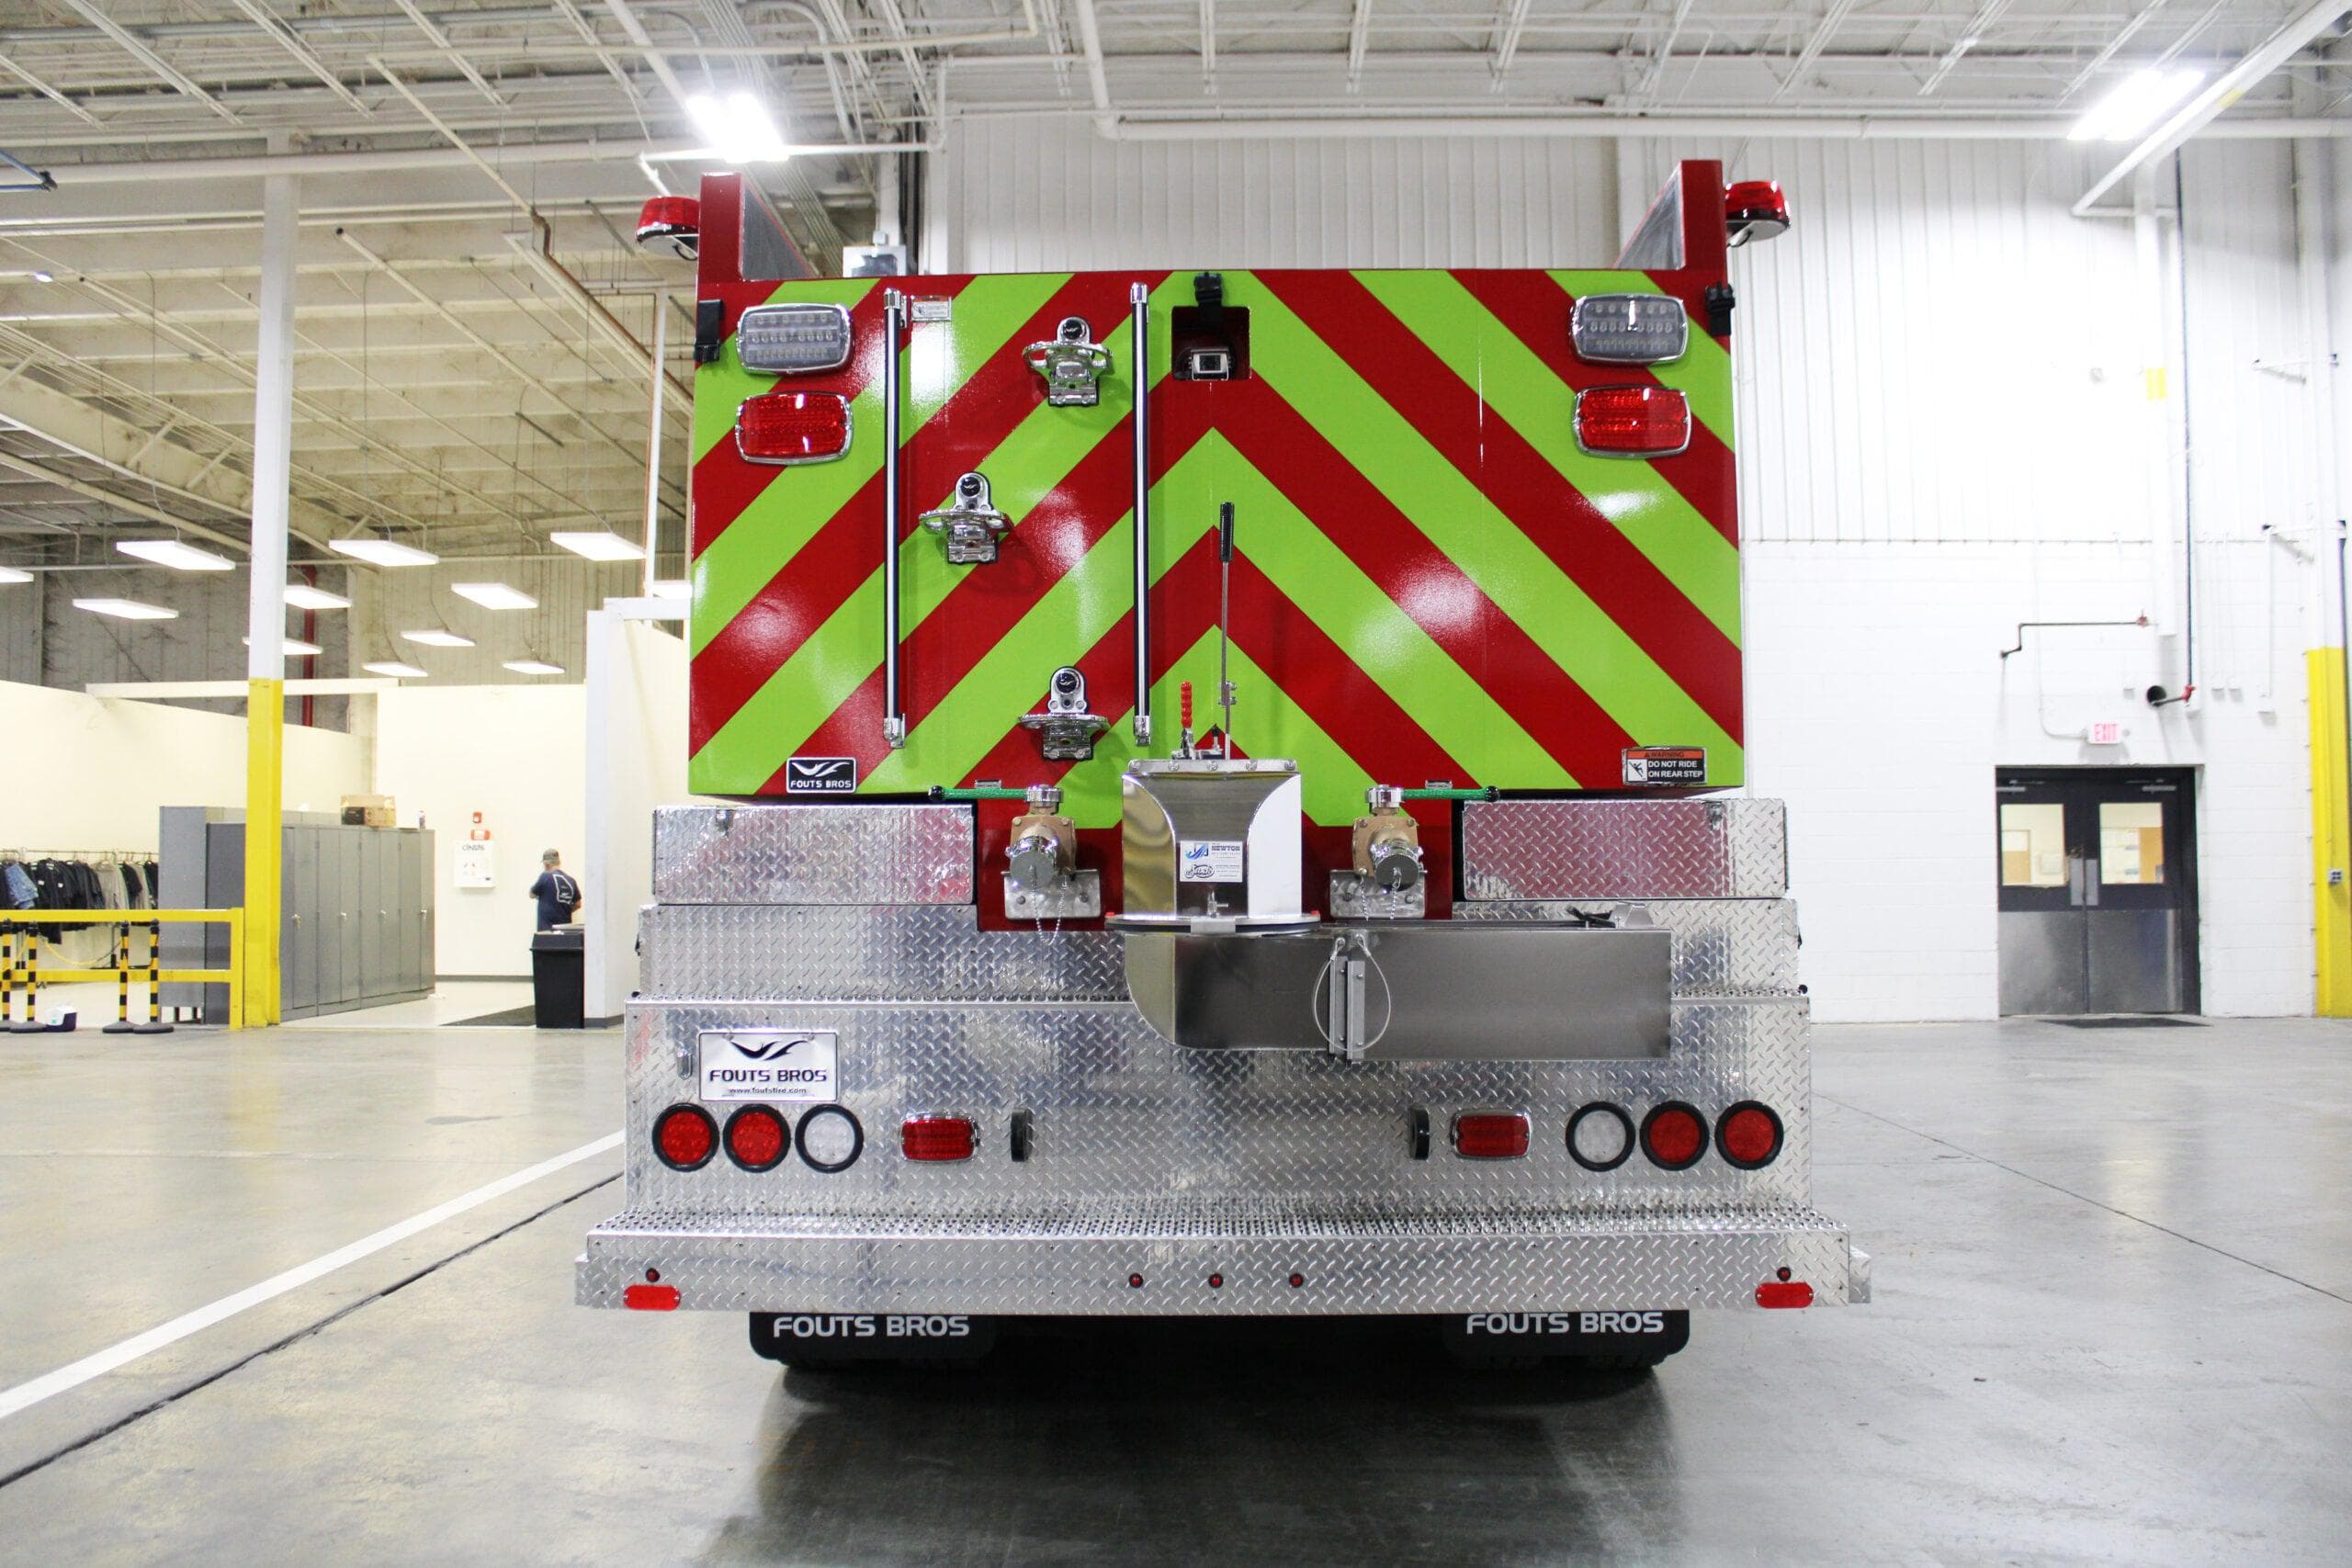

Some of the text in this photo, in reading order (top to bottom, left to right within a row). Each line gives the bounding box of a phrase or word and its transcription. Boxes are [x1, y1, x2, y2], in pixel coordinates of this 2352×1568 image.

[2095, 723, 2117, 741] EXIT
[1660, 770, 1683, 778] REAR
[790, 780, 852, 788] FOUTS BROS
[709, 1069, 827, 1082] FOUTS BROS
[729, 1087, 807, 1095] www.foutsfire.com
[773, 1315, 970, 1337] FOUTS BROS
[1466, 1312, 1665, 1335] FOUTS BROS
